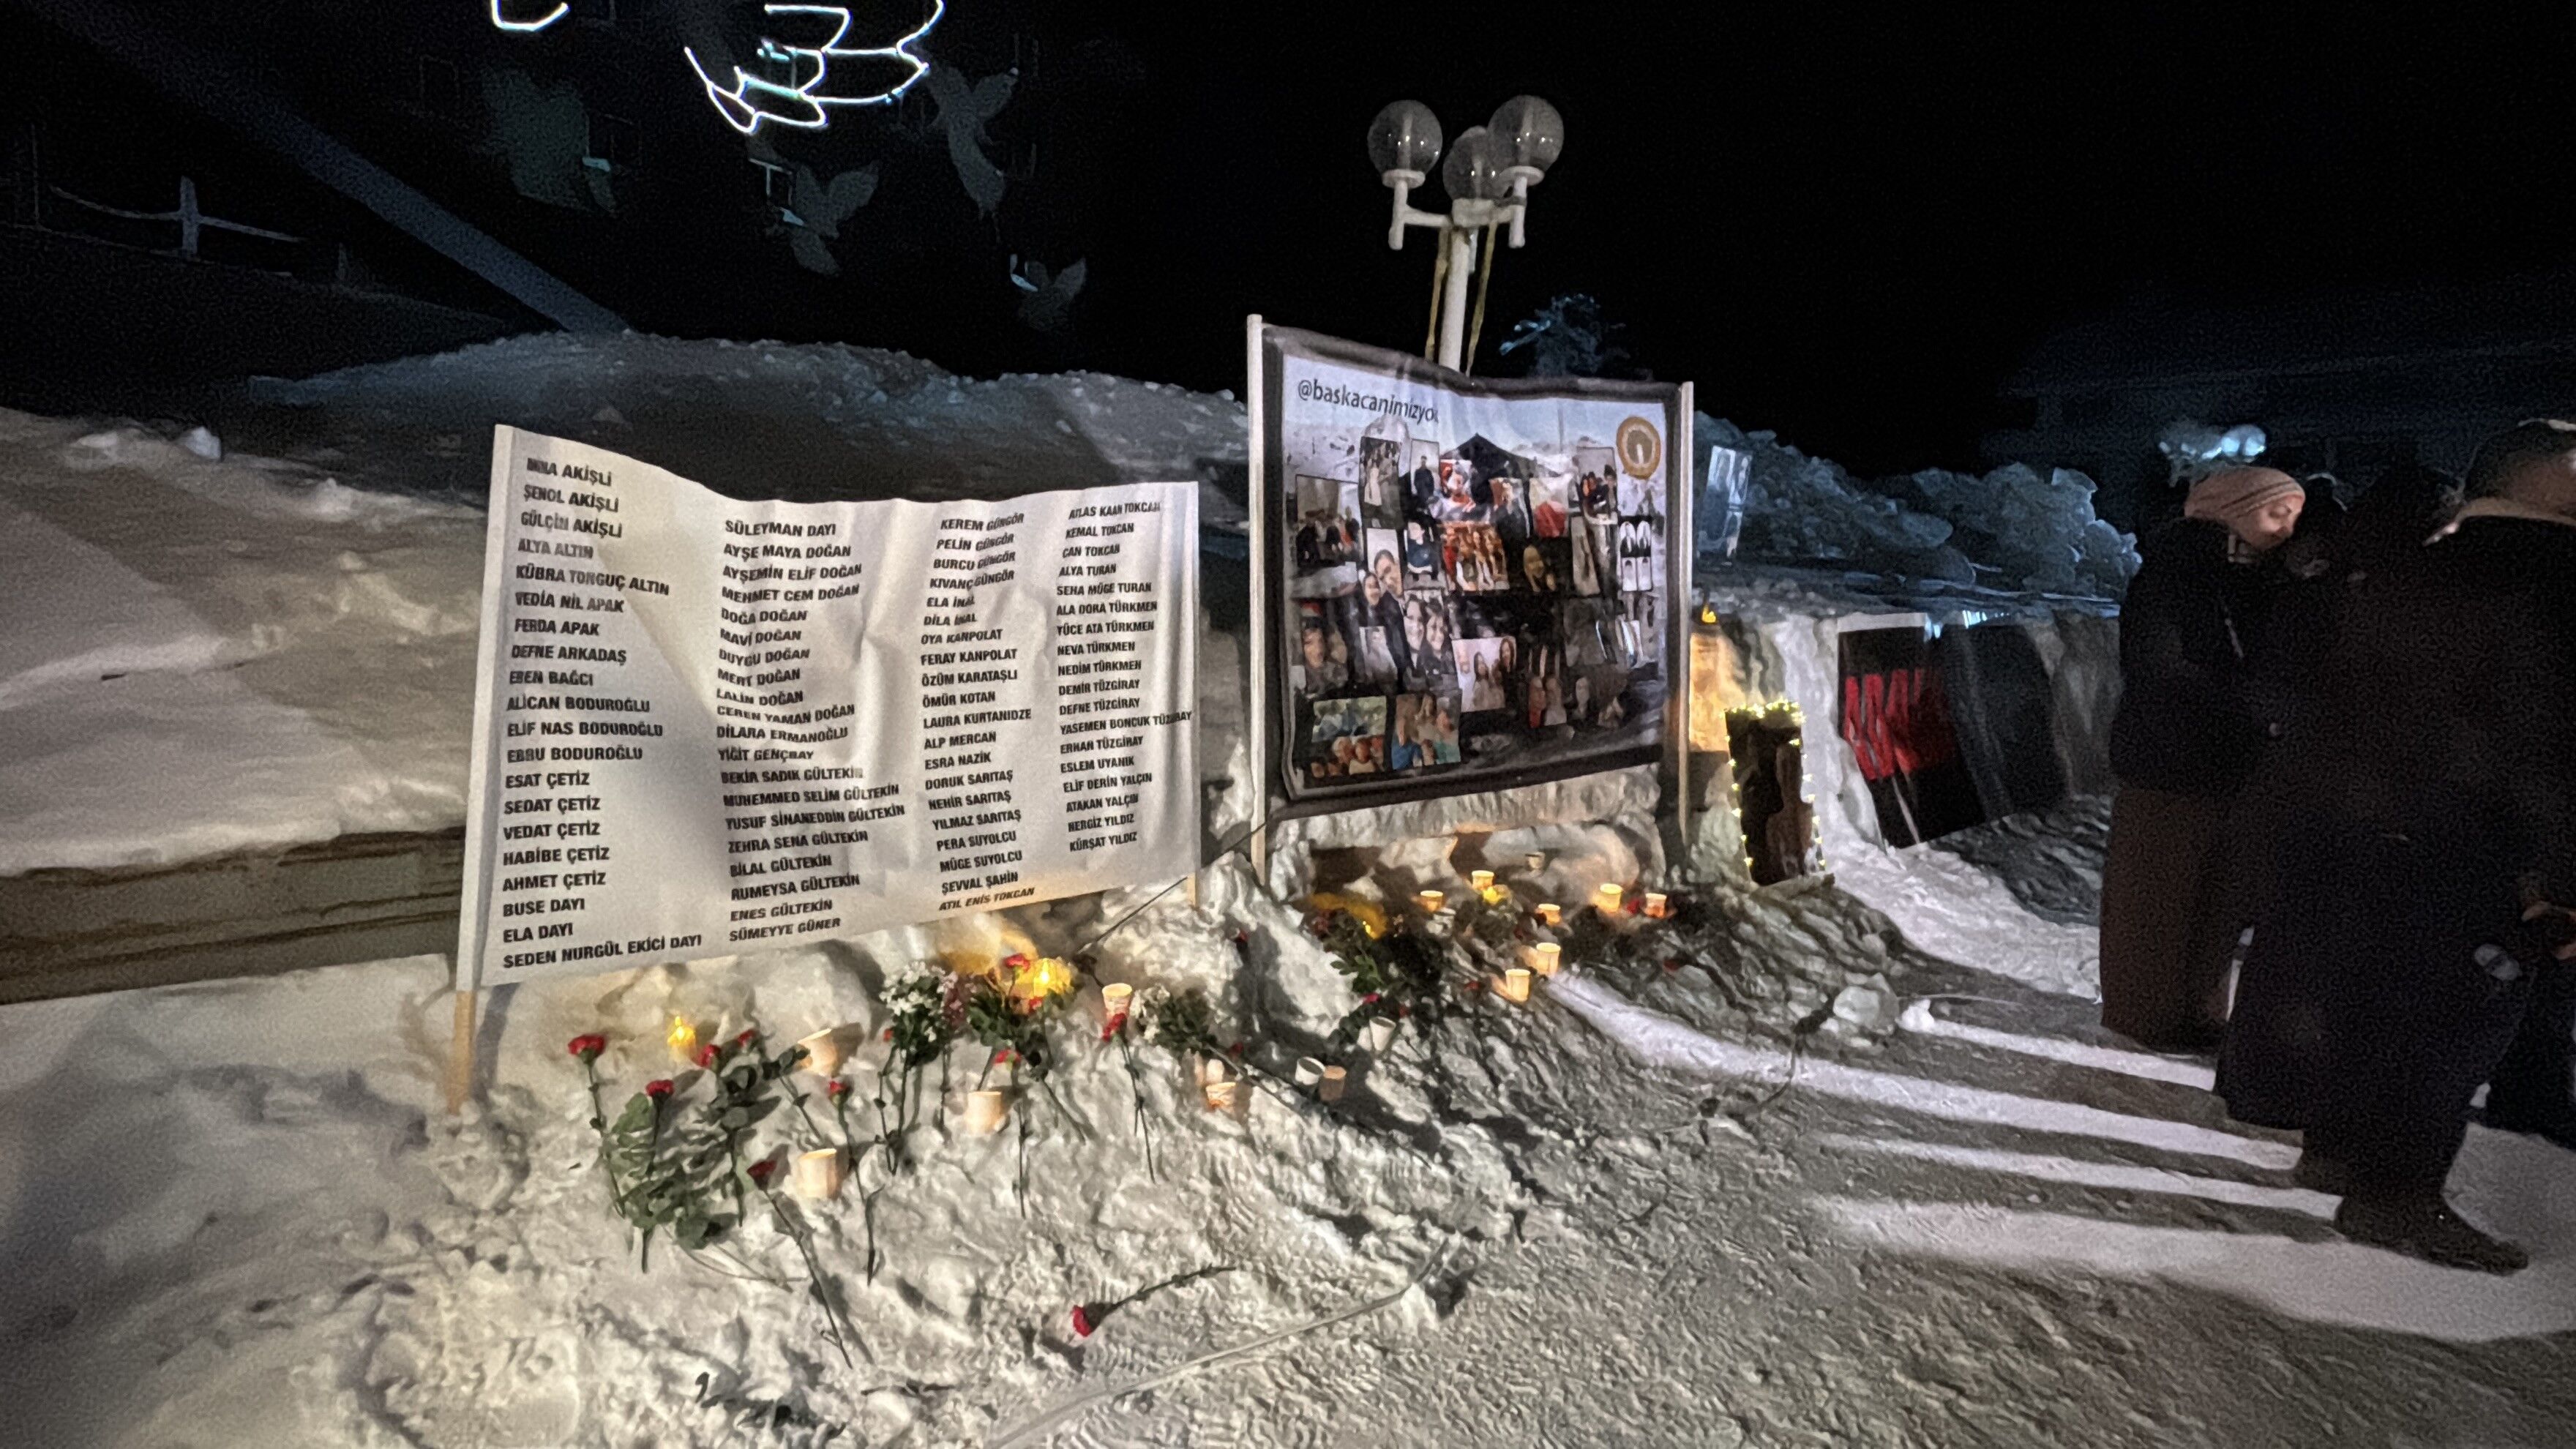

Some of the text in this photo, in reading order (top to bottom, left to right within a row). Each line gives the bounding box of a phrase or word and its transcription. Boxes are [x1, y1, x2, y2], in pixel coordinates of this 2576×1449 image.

[562, 465, 612, 487] AKİŞLİ
[524, 484, 619, 512] ŞENOL AKİŞLİ
[1068, 506, 1097, 520] ATLAS
[573, 517, 622, 538] AKİŞLİ
[725, 520, 836, 536] SÜLEYMAN DAYI
[940, 519, 984, 531] KEREM
[1066, 523, 1134, 539] KEMAL TOKCAN
[518, 539, 551, 554] ALYA
[723, 543, 850, 562] AYŞE MAYA DOĞAN
[936, 538, 971, 550] PELİN
[1063, 544, 1120, 558] CAN TOKCAN
[723, 564, 861, 584] AYŞEMİN ELİF DOĞAN
[933, 559, 976, 571] BURCU
[1059, 564, 1116, 577] ALYA TURAN
[516, 563, 670, 596] KÜBRA ALTIN
[930, 570, 1014, 592] KIVANÇ GÜNGÖR
[1117, 582, 1152, 593] TURAN
[722, 583, 859, 603] MEHMET CEM DOĞAN
[561, 593, 624, 613] NİL APAK
[927, 598, 948, 607] ELA
[1056, 600, 1157, 616] ALA TÜRKMEN
[722, 607, 807, 625] DOĞA DOĞAN
[924, 614, 951, 626] DİLA
[514, 618, 599, 635] FERDA APAK
[1057, 621, 1154, 636] YÜCE ATA TÜRKMEN
[755, 629, 801, 643] DOĞAN
[921, 629, 1003, 645] OYA KANPOLAT
[512, 645, 626, 666] DEFNE ARKADAŞ
[719, 648, 809, 666] DUYGU DOĞAN
[921, 648, 1017, 665] FERAY KANPOLAT
[1057, 641, 1135, 656] NEVA TÜRKMEN
[717, 667, 801, 686] MERT DOĞAN
[1058, 660, 1142, 676] NEDİM TÜRKMEN
[549, 670, 594, 686] BAĞCI
[922, 670, 1017, 686] ÖZÜM KARATAŞLI
[1059, 679, 1140, 695] DEMİR TÜZGİRAY
[506, 695, 650, 713] ALİCAN BODUROĞLU
[716, 688, 804, 705] LALİN DOĞAN
[922, 692, 995, 708] ÖMÜR KOTAN
[717, 704, 855, 724] CEREN YAMAN DOĞAN
[1060, 698, 1140, 716] DEFNE TÜZGİRAY
[924, 708, 1032, 729] LAURA KURTANIDZE
[1060, 716, 1150, 735] YASEMEN BONCUK
[508, 721, 663, 737] ELİF NAS BODUROĞLU
[717, 724, 848, 744] DİLARA ERMANOĞLU
[924, 732, 997, 749] ALP MERCAN
[1096, 735, 1143, 749] TÜZGİRAY
[551, 744, 643, 760] BODUROĞLU
[718, 747, 750, 761] YİĞİT
[925, 749, 991, 770] ESRA NAZİK
[1060, 756, 1134, 774] ESLEM UYANIK
[506, 769, 590, 789] ESAT ÇETİZ
[721, 770, 800, 784] BEKİR SADIK
[925, 770, 1013, 790] DORUK SARITAŞ
[1063, 773, 1152, 793] ELİF DERİN YALÇIN
[804, 782, 899, 803] SELİM GÜLTEKİN
[928, 790, 1011, 810] NEHİR SARITAŞ
[504, 794, 600, 815] SEDAT ÇETİZ
[1066, 798, 1103, 813] ATAKAN
[725, 803, 905, 831] YUSUF GÜLTEKİN
[932, 809, 1022, 831] YILMAZ SARITAŞ
[1104, 813, 1134, 826] YILDIZ
[503, 820, 600, 839] VEDAT ÇETİZ
[729, 829, 868, 853] ZEHRA SENA GÜLTEKİN
[937, 831, 1016, 852] PERA SUYOLCU
[1070, 831, 1137, 852] KÜRŞAT YILDIZ
[503, 845, 610, 865] HABİBE ÇETİZ
[940, 850, 1022, 872] MÜGE SUYOLCU
[730, 853, 831, 877] BİLAL GÜLTEKİN
[503, 869, 606, 891] AHMET ÇETİZ
[732, 872, 860, 901] RUMEYSA GÜLTEKİN
[942, 870, 1018, 896] ŞEVVAL ŞAHİN
[965, 887, 1035, 907] ENİS TOKCAN
[503, 898, 585, 916] BUSE DAYI
[730, 898, 832, 921] ENES GÜLTEKİN
[503, 923, 573, 943] ELA DAYI
[729, 918, 841, 942] SÜMEYYE GÜNER
[503, 934, 702, 968] SEDEN NURGÜL EKİCİ DAYI
